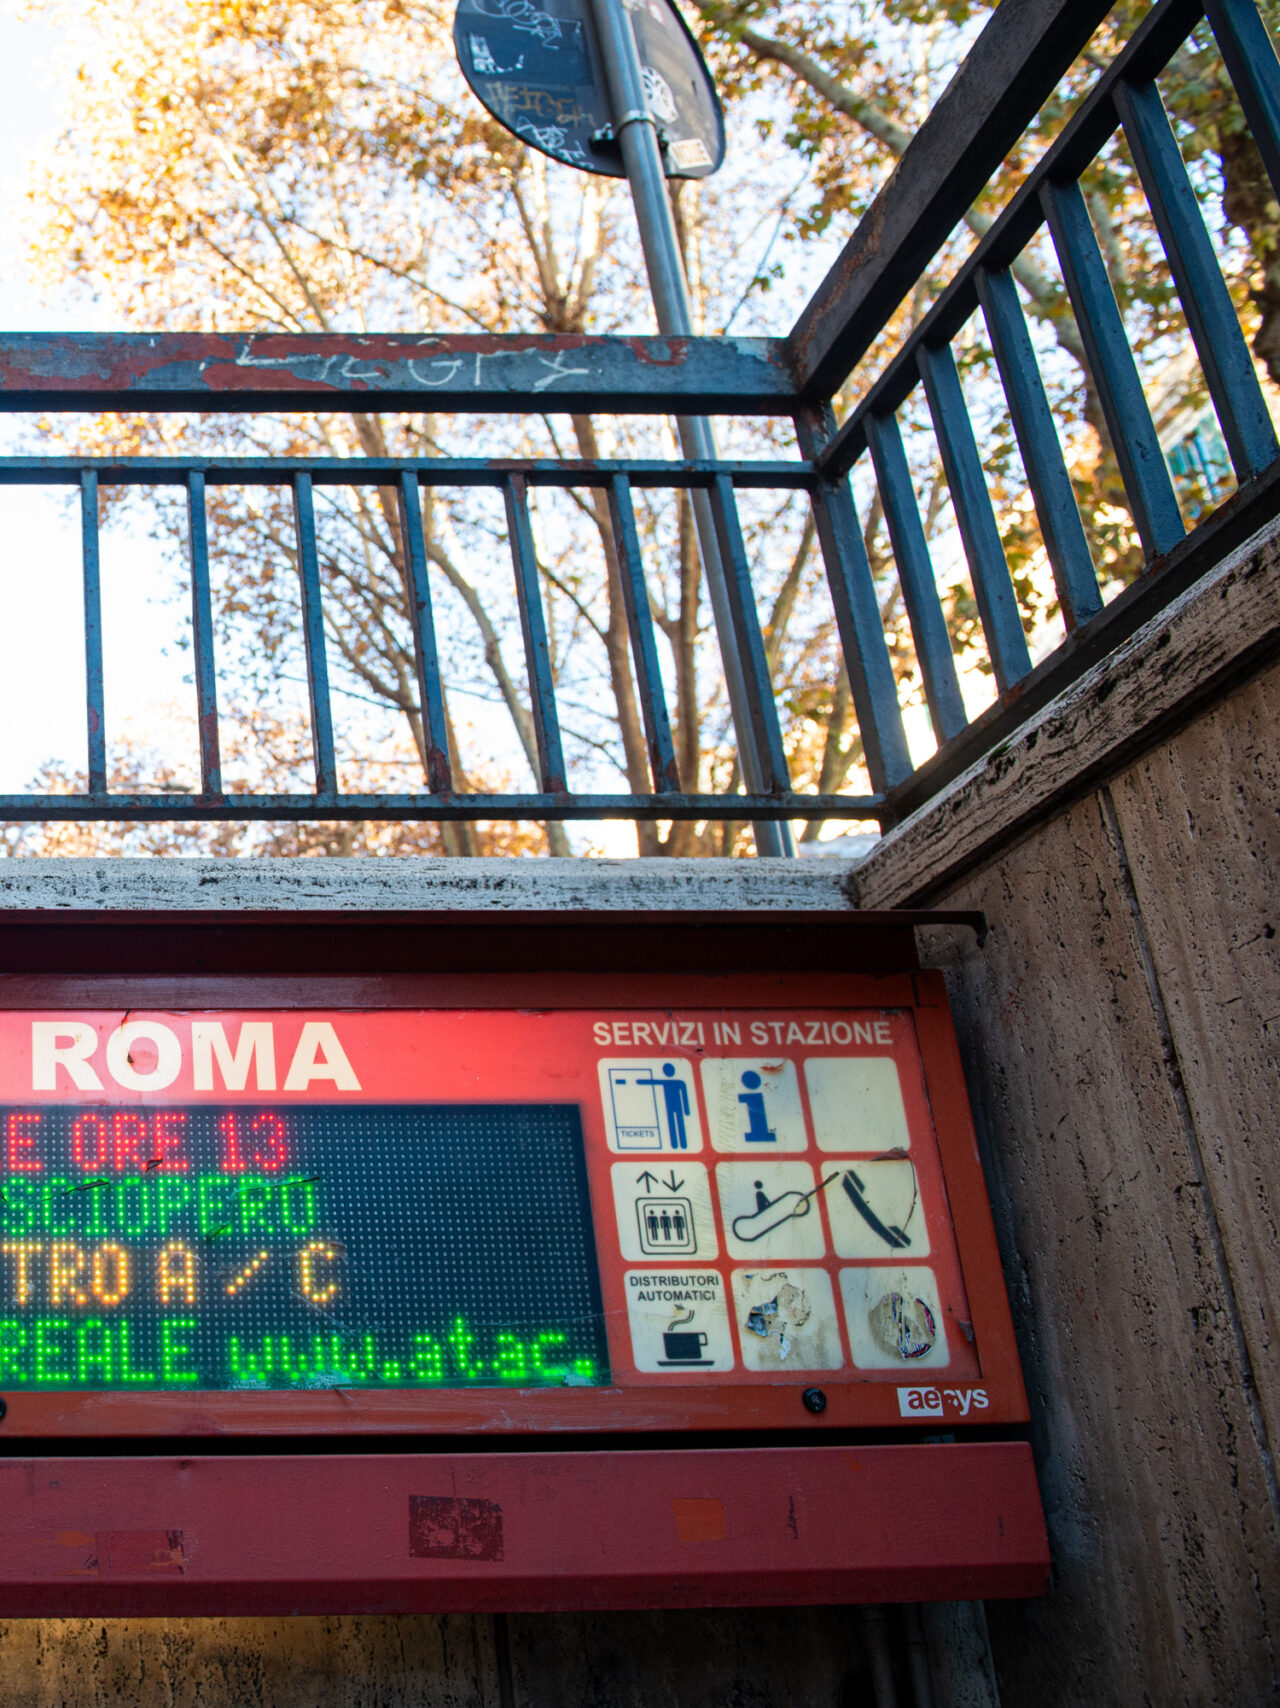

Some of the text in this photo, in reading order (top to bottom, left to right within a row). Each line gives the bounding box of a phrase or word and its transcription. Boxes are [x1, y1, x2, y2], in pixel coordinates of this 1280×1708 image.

[592, 1021, 893, 1046] SERVIZI IN STAZIONE
[31, 1019, 362, 1092] ROMA
[72, 1112, 190, 1172] ORE
[219, 1112, 288, 1171] 13
[620, 1129, 656, 1139] TICKETS
[1, 1175, 316, 1237] SCIOPERO
[156, 1241, 196, 1304] A
[300, 1241, 338, 1304] C
[629, 1275, 719, 1287] DISTRIBUTORI
[637, 1290, 716, 1302] AUTOMATICI
